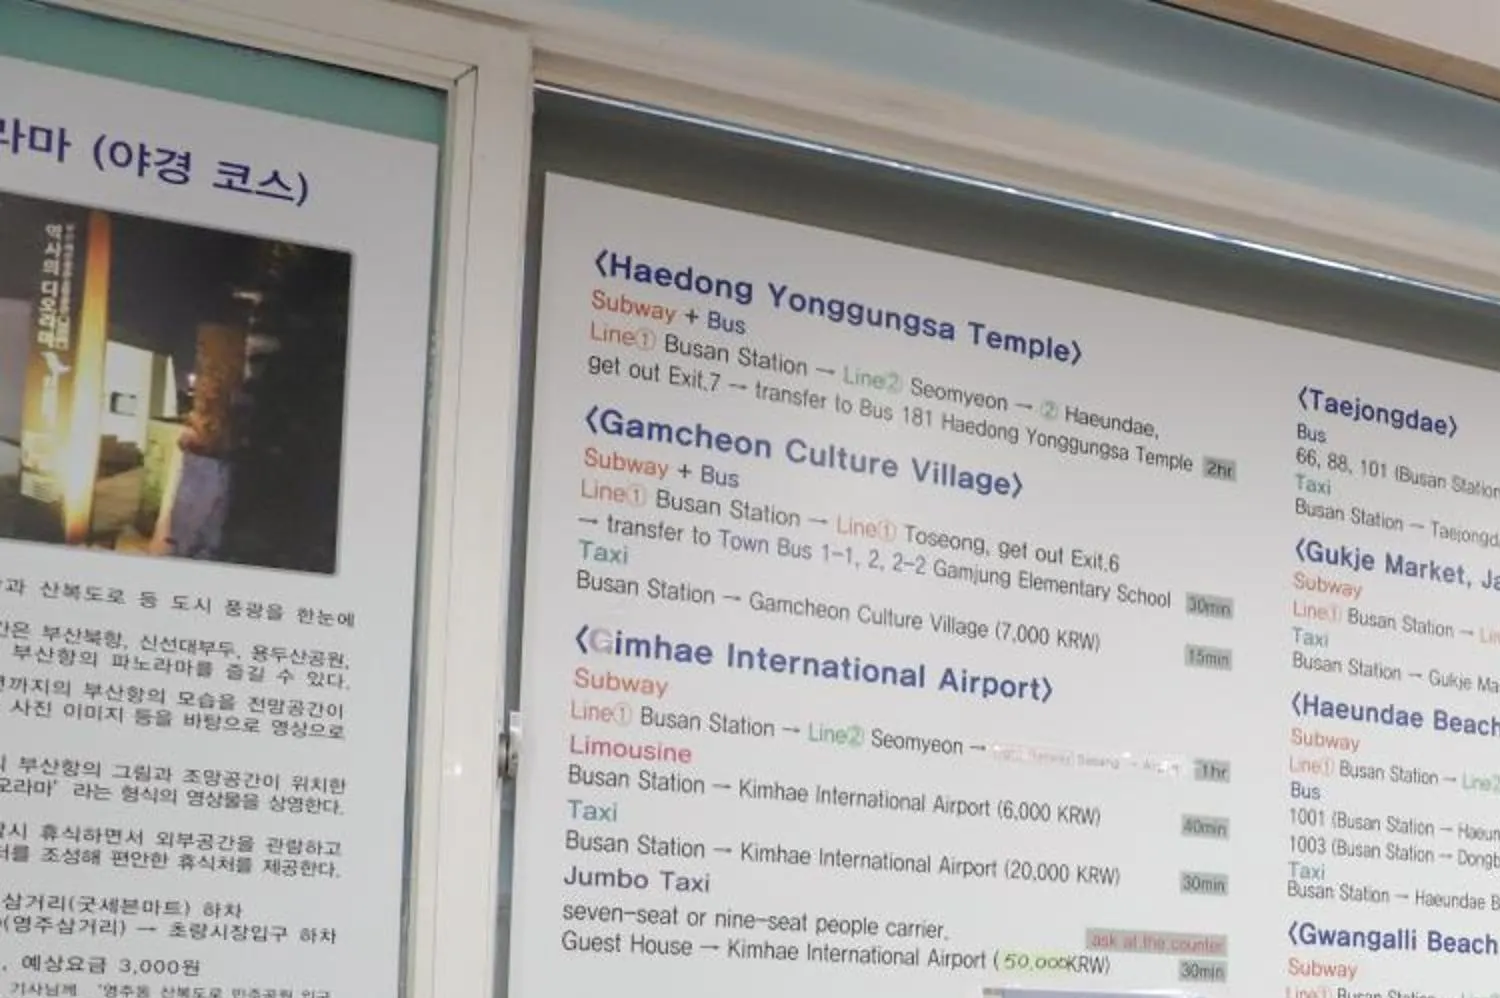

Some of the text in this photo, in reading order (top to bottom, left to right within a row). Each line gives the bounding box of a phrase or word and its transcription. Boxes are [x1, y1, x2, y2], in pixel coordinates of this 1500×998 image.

[93, 134, 192, 186] (야경
[214, 160, 309, 208] 코스)
[592, 289, 746, 335] Subway Bus
[768, 283, 955, 341] Yonggungsa
[662, 332, 735, 369] Busan
[737, 346, 808, 376] Station
[910, 377, 1008, 417] Seomyeon
[1065, 405, 1159, 443] Haeundae,
[588, 356, 621, 376] get
[628, 363, 661, 383] out
[755, 380, 827, 409] transfer
[835, 394, 853, 414] to
[859, 398, 893, 422] Bus
[903, 406, 932, 427] 181
[941, 412, 1019, 445] Haedong
[1025, 427, 1130, 461] Yonggungsa
[1136, 445, 1193, 472] Temple
[1297, 423, 1328, 444] Bus
[584, 447, 739, 488] Subway Bus
[786, 439, 898, 477] Culture
[1296, 447, 1321, 470] 66,
[655, 488, 721, 517] Busan
[728, 499, 801, 528] Station
[904, 524, 992, 557] Toseong,
[998, 540, 1028, 562] get
[1034, 546, 1064, 566] out
[579, 539, 629, 565] Taxi
[607, 514, 685, 542] transfer
[691, 526, 711, 547] to
[718, 529, 769, 554] Town
[777, 537, 812, 560] Bus
[1017, 569, 1111, 602] Elementary
[1117, 583, 1171, 608] School
[1386, 552, 1471, 588] Market,
[1294, 571, 1363, 600] Subway
[12, 643, 350, 690] 부산항의 파노라마를 즐길 수 있다.
[574, 667, 668, 699] Subway
[727, 642, 925, 688] International
[570, 734, 694, 764] Limousine
[567, 799, 618, 822] Taxi
[568, 763, 631, 789] Busan
[637, 769, 705, 794] Station
[739, 778, 809, 803] Kimhae
[816, 785, 926, 813] International
[932, 795, 991, 817] Airport
[997, 800, 1051, 823] (6,000
[1057, 805, 1101, 828] KRW)
[563, 865, 710, 893] Jumbo Taxi
[562, 899, 680, 927] seven-seat
[686, 911, 708, 927] or
[714, 909, 807, 932] nine-seat
[815, 915, 879, 940] people
[561, 929, 622, 953] Guest
[629, 932, 693, 956] House
[727, 938, 799, 961] Kimhae
[807, 942, 920, 966] International
[927, 947, 986, 970] Airport
[1428, 930, 1498, 955] Beach
[21, 954, 200, 977] 예상요금 3,000원
[1288, 957, 1358, 982] Subway
